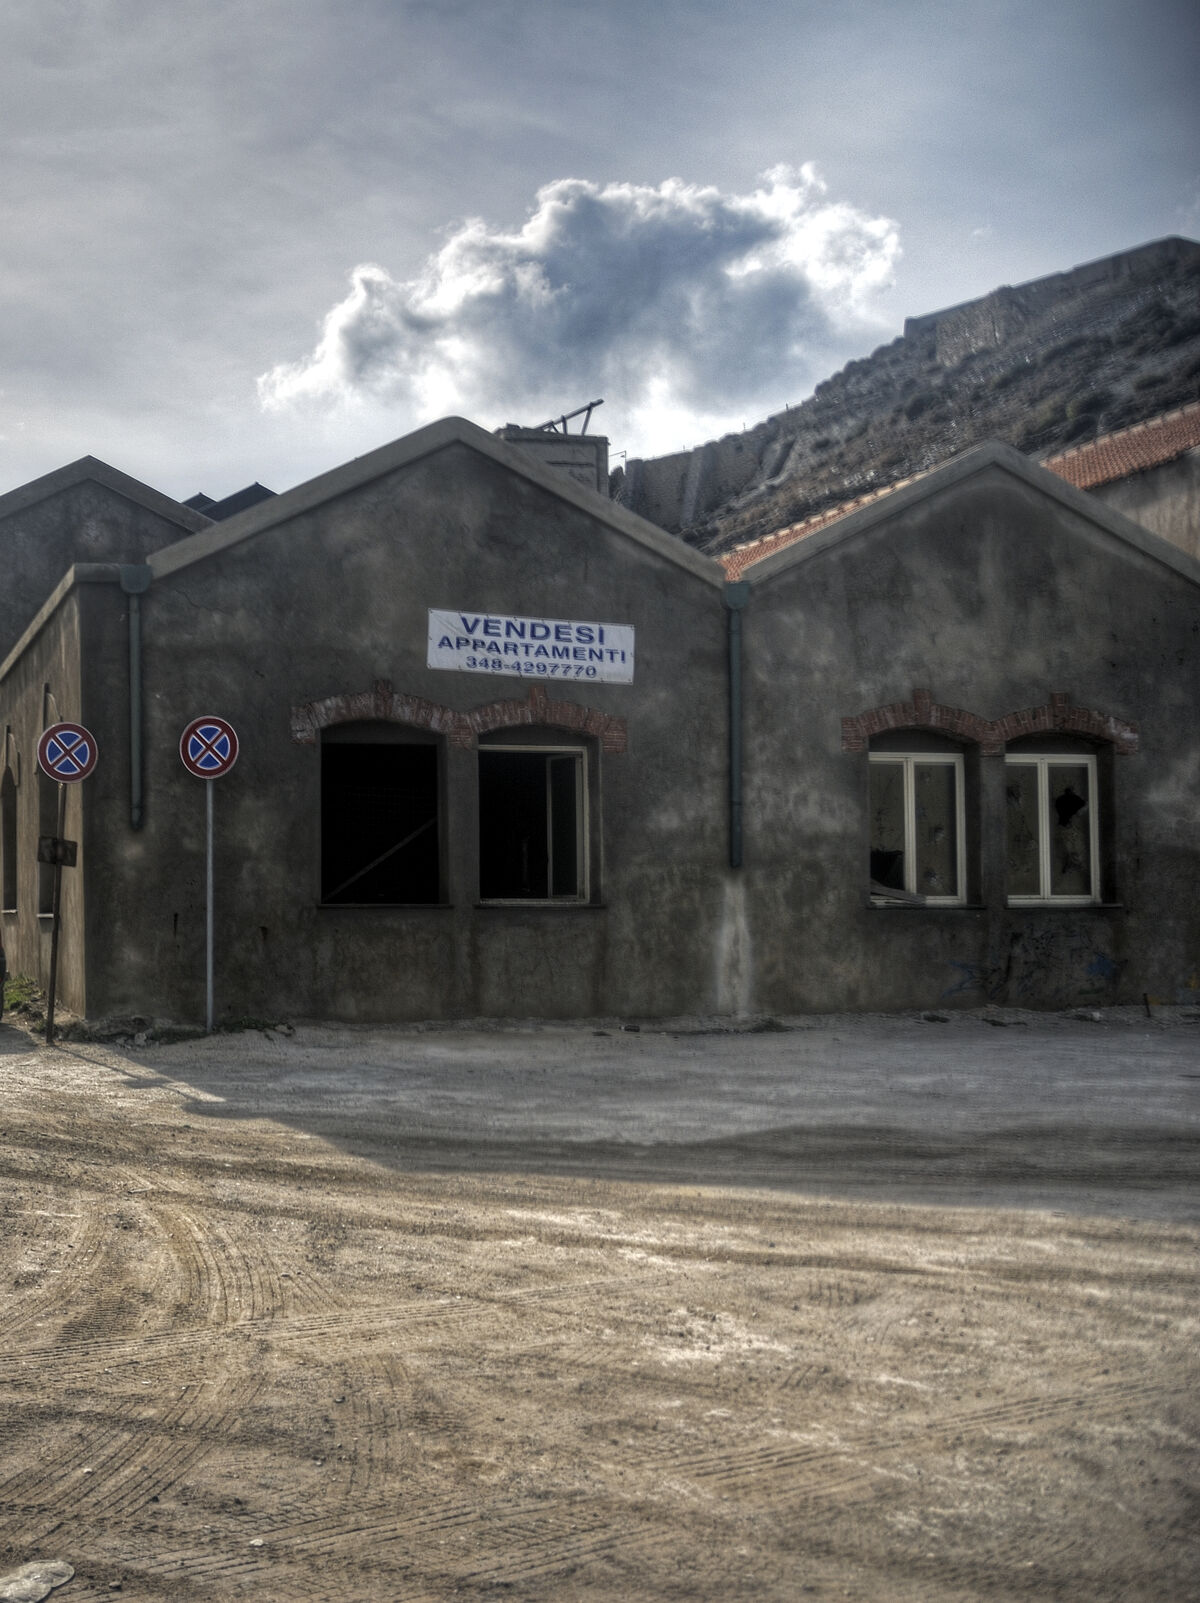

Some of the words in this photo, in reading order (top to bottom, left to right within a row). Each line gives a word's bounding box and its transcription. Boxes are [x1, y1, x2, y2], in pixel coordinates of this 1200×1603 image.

[461, 617, 605, 645] VENDESI
[438, 636, 626, 664] APPARTAMENTI
[466, 656, 597, 678] 348-4297770
